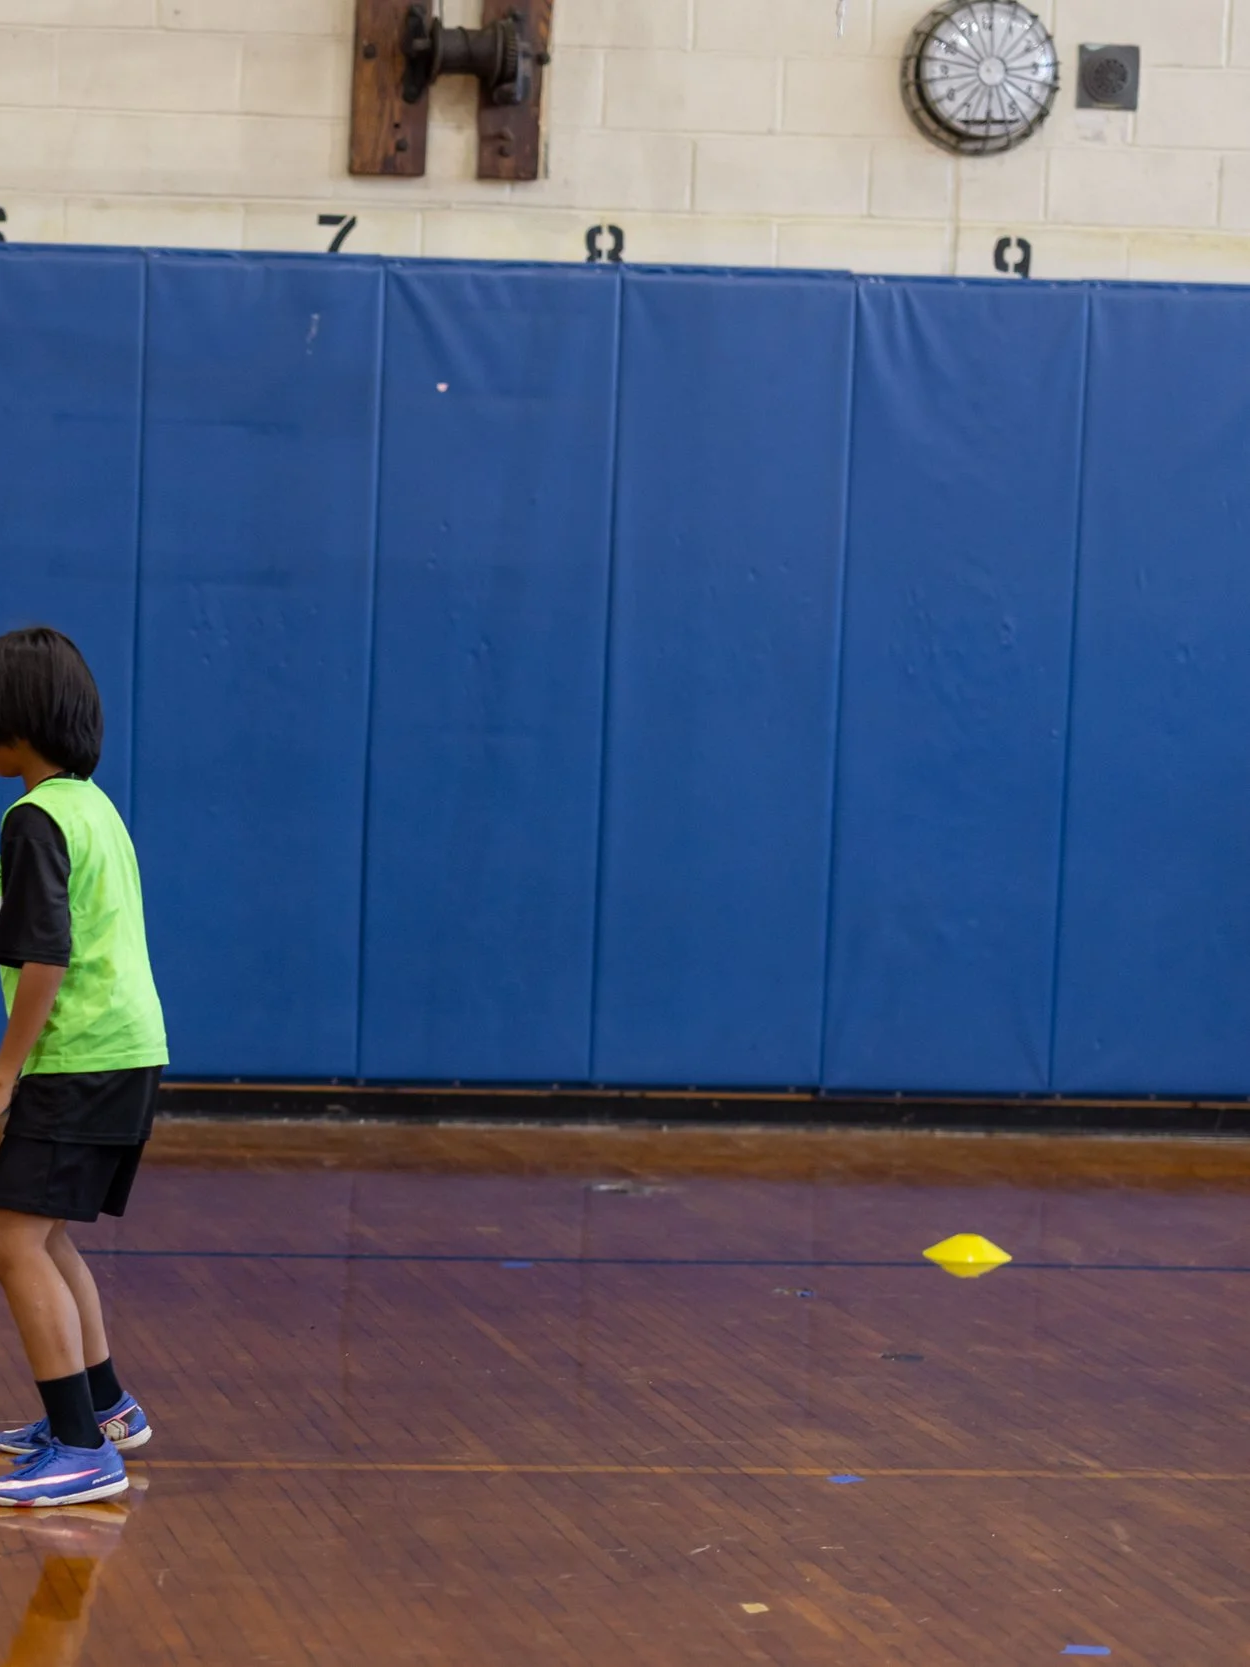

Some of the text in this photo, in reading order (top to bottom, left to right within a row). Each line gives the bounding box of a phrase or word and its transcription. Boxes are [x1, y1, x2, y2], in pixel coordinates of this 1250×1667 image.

[318, 214, 356, 252] 7
[586, 225, 624, 263] 8
[994, 237, 1031, 278] 9
